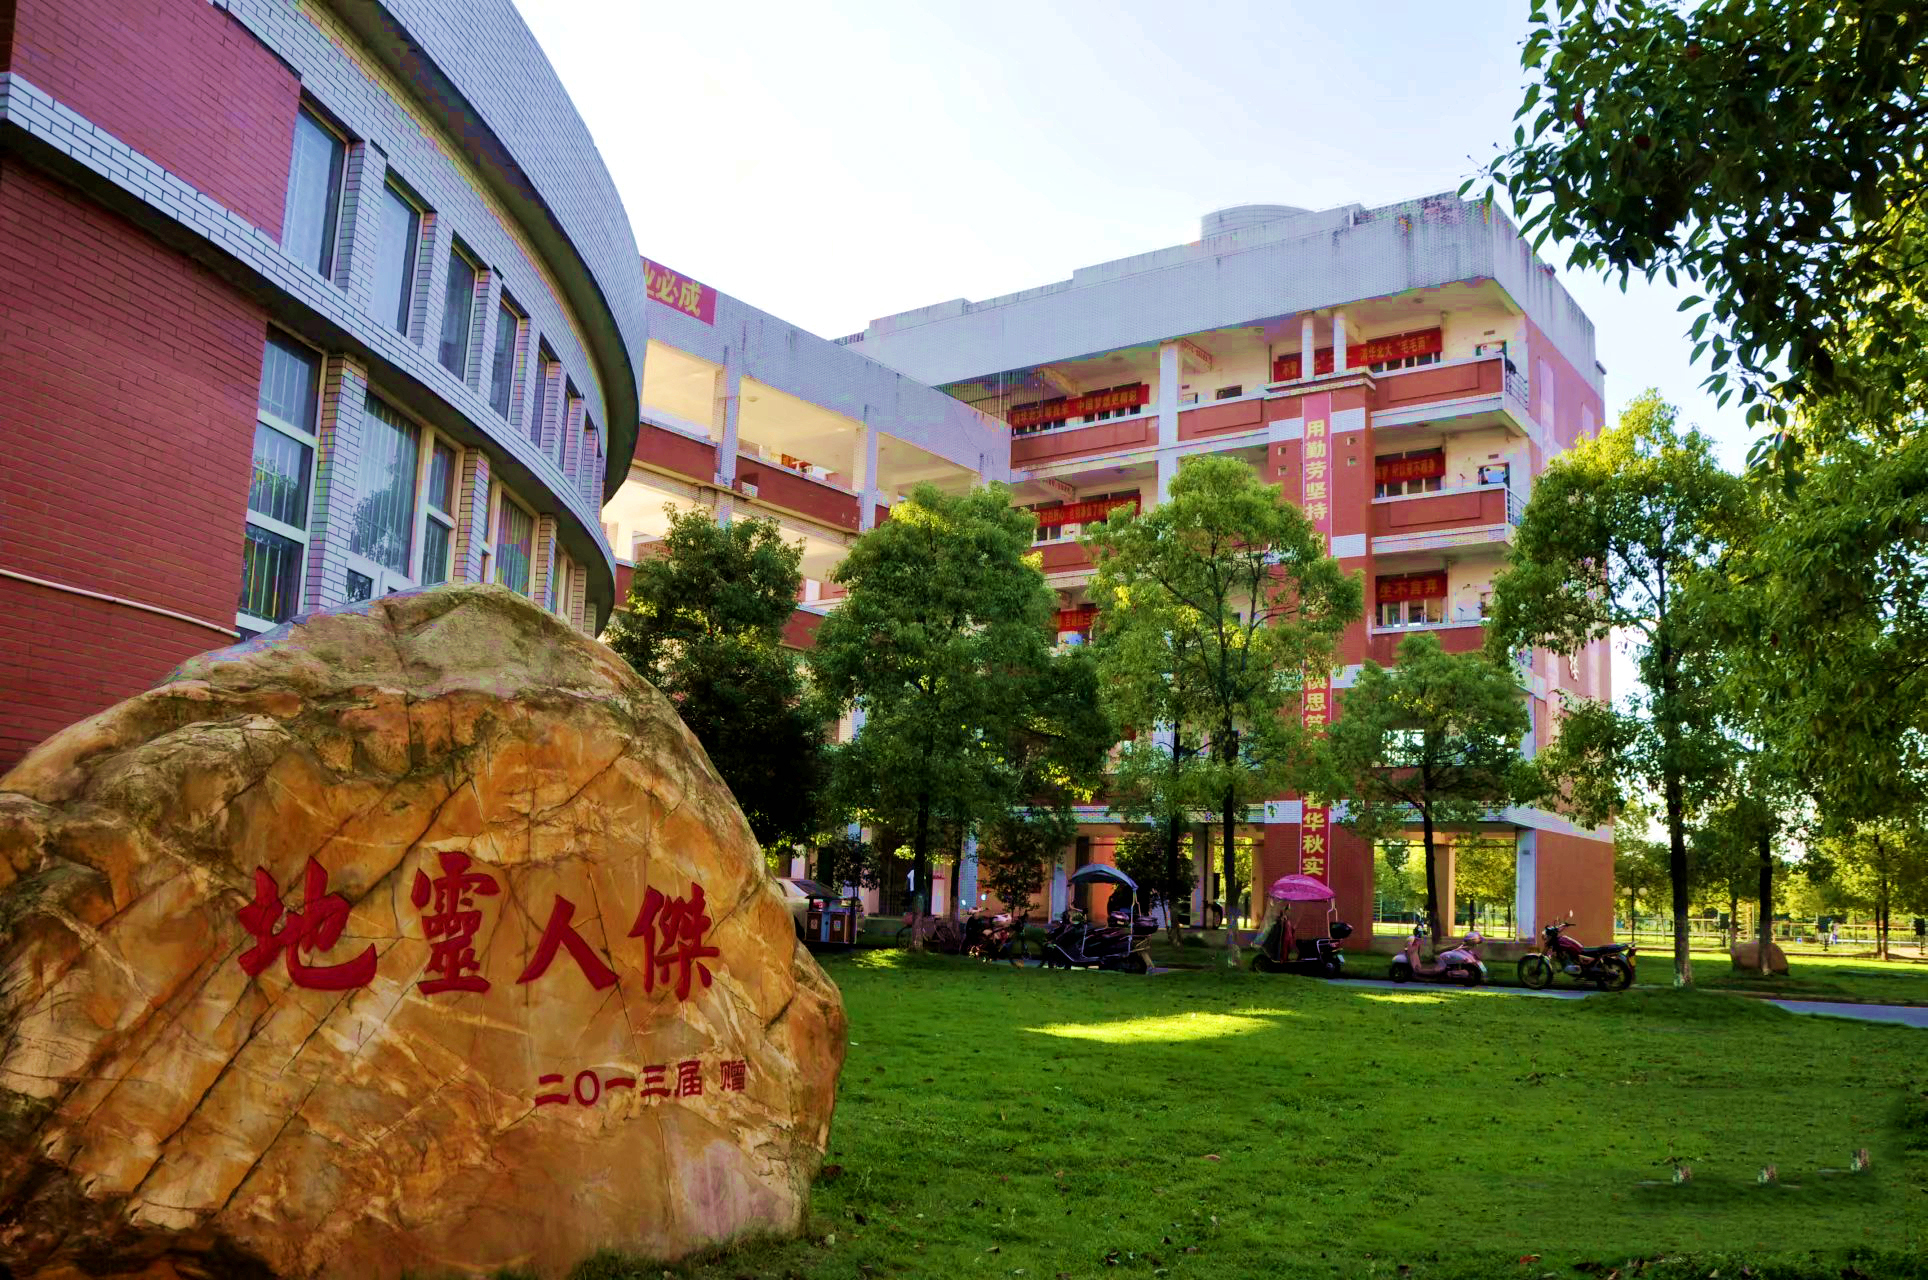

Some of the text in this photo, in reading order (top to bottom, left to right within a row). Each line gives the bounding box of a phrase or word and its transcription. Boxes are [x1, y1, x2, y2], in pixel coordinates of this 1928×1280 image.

[1305, 419, 1328, 521] 用勤劳坚持
[1302, 791, 1325, 875] 春华秋实
